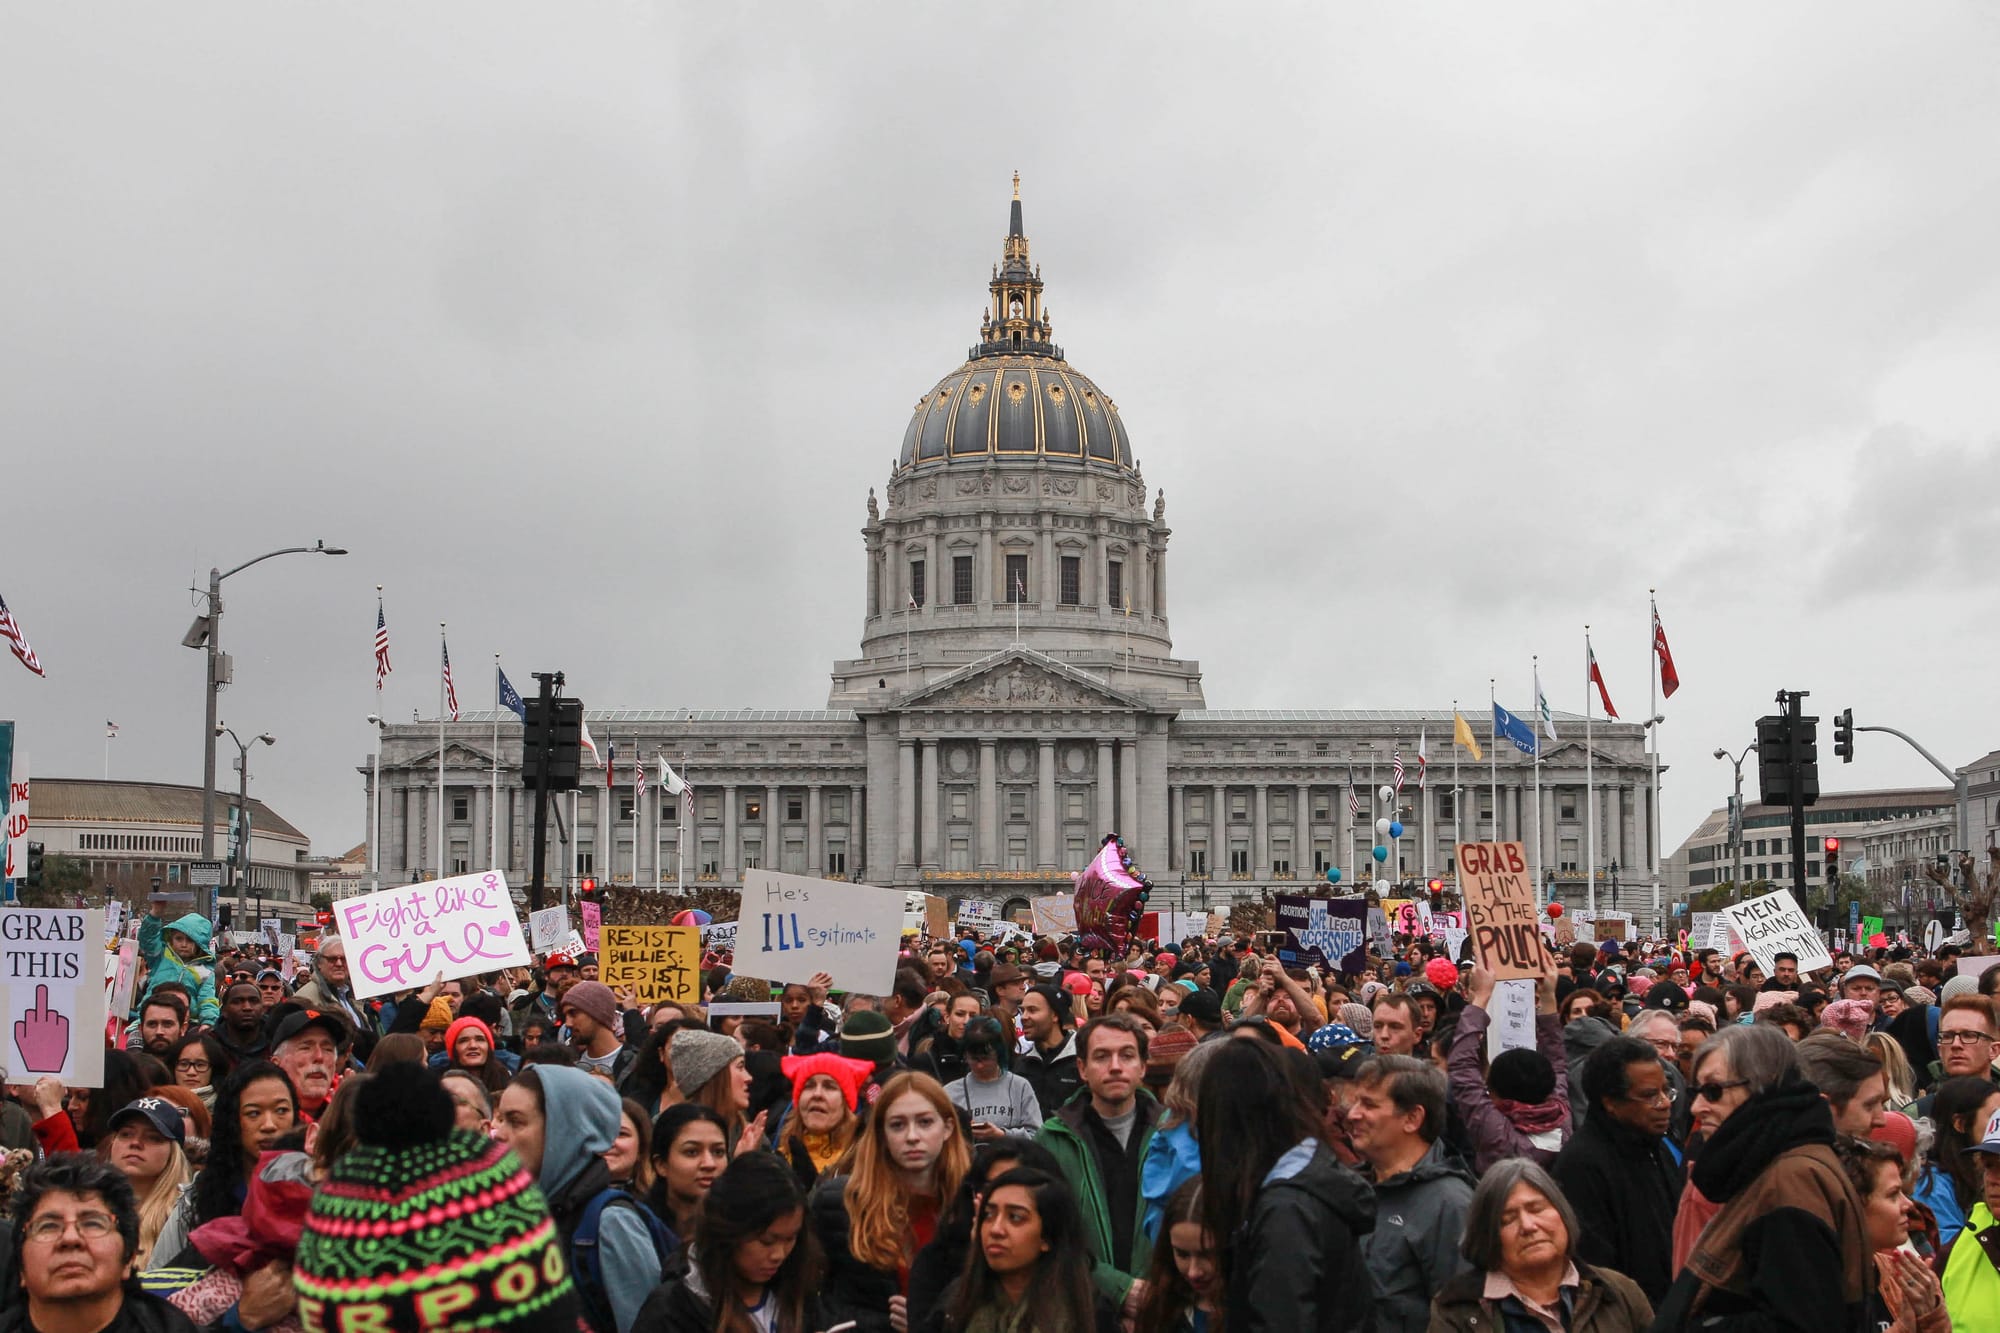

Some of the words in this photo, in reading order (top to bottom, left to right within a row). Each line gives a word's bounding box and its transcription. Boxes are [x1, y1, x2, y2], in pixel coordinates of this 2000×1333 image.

[1461, 843, 1525, 875] GRAB
[766, 881, 809, 903] He's
[1479, 875, 1525, 899] HIM
[344, 892, 429, 939] Fight
[434, 886, 498, 918] like
[1279, 904, 1310, 919] ABORTION:
[1470, 901, 1497, 925] BY
[1498, 902, 1533, 920] THE
[1731, 896, 1782, 925] MEN
[2, 913, 85, 941] GRAB
[413, 920, 437, 936] a
[608, 928, 686, 947] RESIST
[1744, 910, 1806, 943] AGAINST
[610, 949, 683, 968] BULLIES:
[1300, 930, 1361, 961] ACCESSIBLE
[1476, 923, 1546, 973] POLICY
[6, 951, 79, 979] THIS
[605, 966, 691, 984] RESIST
